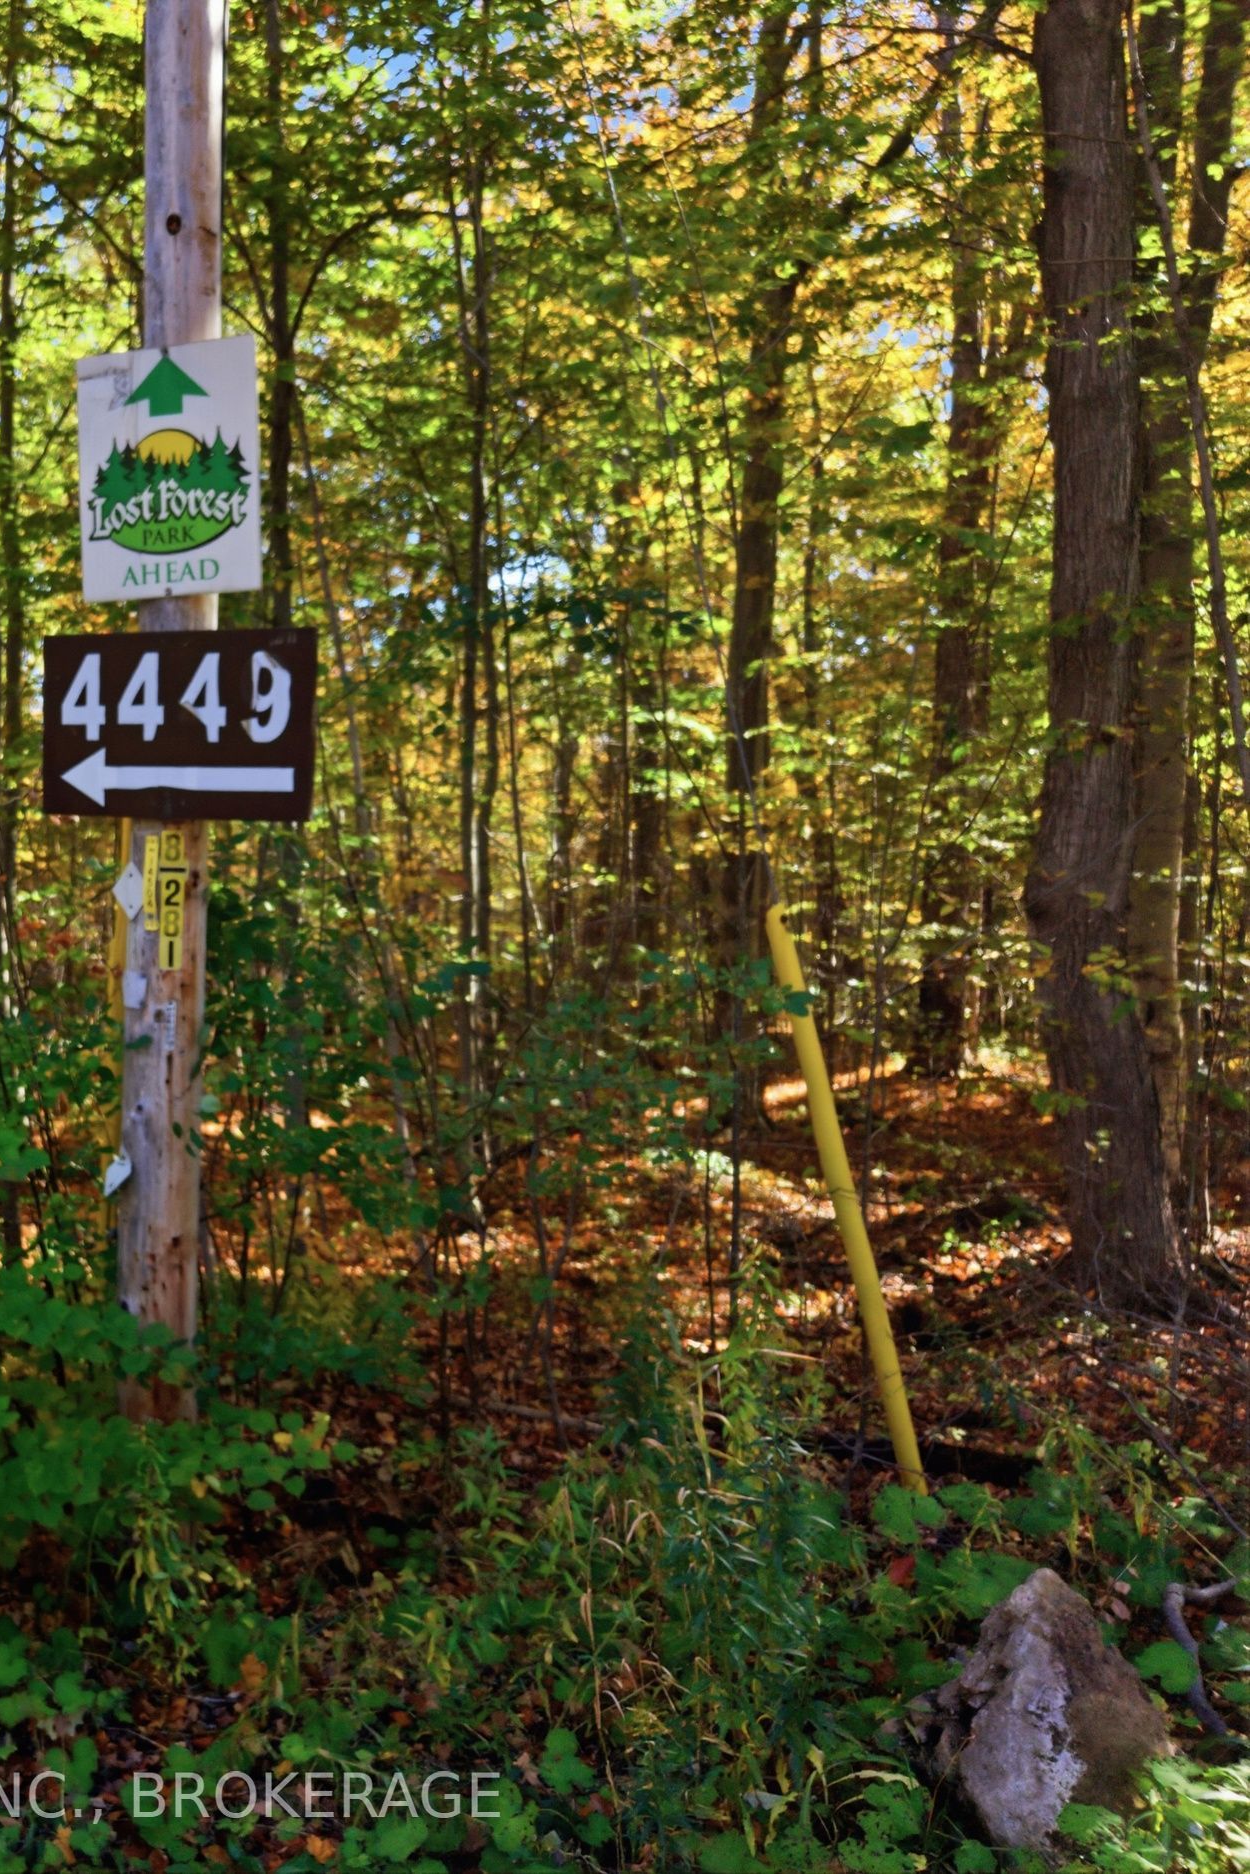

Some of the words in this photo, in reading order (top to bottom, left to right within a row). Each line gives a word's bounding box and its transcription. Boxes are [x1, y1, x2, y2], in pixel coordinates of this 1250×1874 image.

[89, 484, 156, 541] Lost
[155, 477, 247, 527] Forest
[142, 525, 196, 547] PARK
[121, 557, 221, 588] AHEAD
[60, 650, 292, 744] 4449
